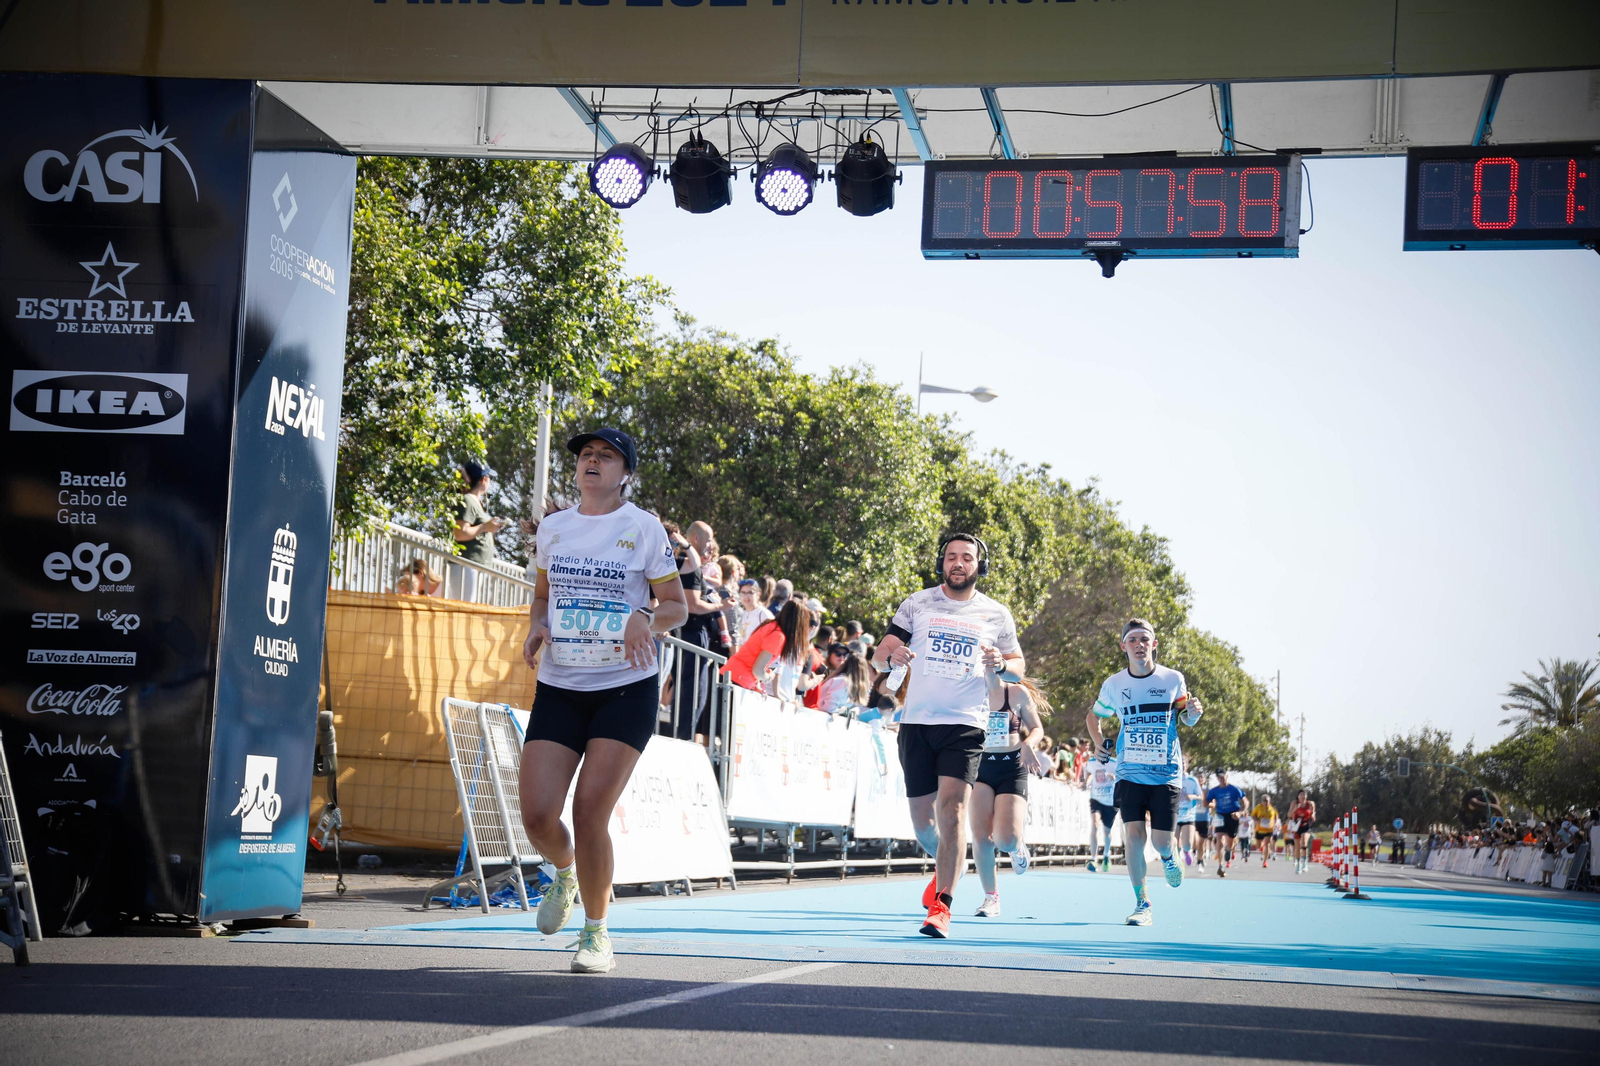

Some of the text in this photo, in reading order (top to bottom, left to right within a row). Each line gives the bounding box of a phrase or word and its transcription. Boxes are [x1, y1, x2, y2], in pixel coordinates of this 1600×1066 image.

[23, 149, 162, 204] CASI
[269, 253, 294, 281] 2005
[270, 233, 335, 286] COOPERACIÓN
[15, 297, 195, 323] ESTRELLA
[56, 322, 154, 335] DE LEVANTE
[36, 388, 166, 416] IKEA
[270, 421, 286, 436] 2020
[60, 471, 127, 488] Barceló
[58, 490, 128, 507] Cabo de
[57, 508, 97, 525] Gata
[43, 541, 132, 592] ego
[552, 555, 627, 571] Medio Maratón
[549, 564, 626, 581] Almería 2024
[98, 582, 136, 594] sport center
[30, 612, 80, 630] SER
[560, 609, 623, 632] 5078
[253, 635, 299, 663] ALMERÍA
[931, 639, 973, 658] 5500
[29, 652, 135, 665] La Voz de Almería
[264, 662, 289, 677] CIUDAD
[26, 683, 129, 717] Coca-Cola
[23, 732, 122, 759] Andalucía
[1129, 733, 1163, 745] 5186
